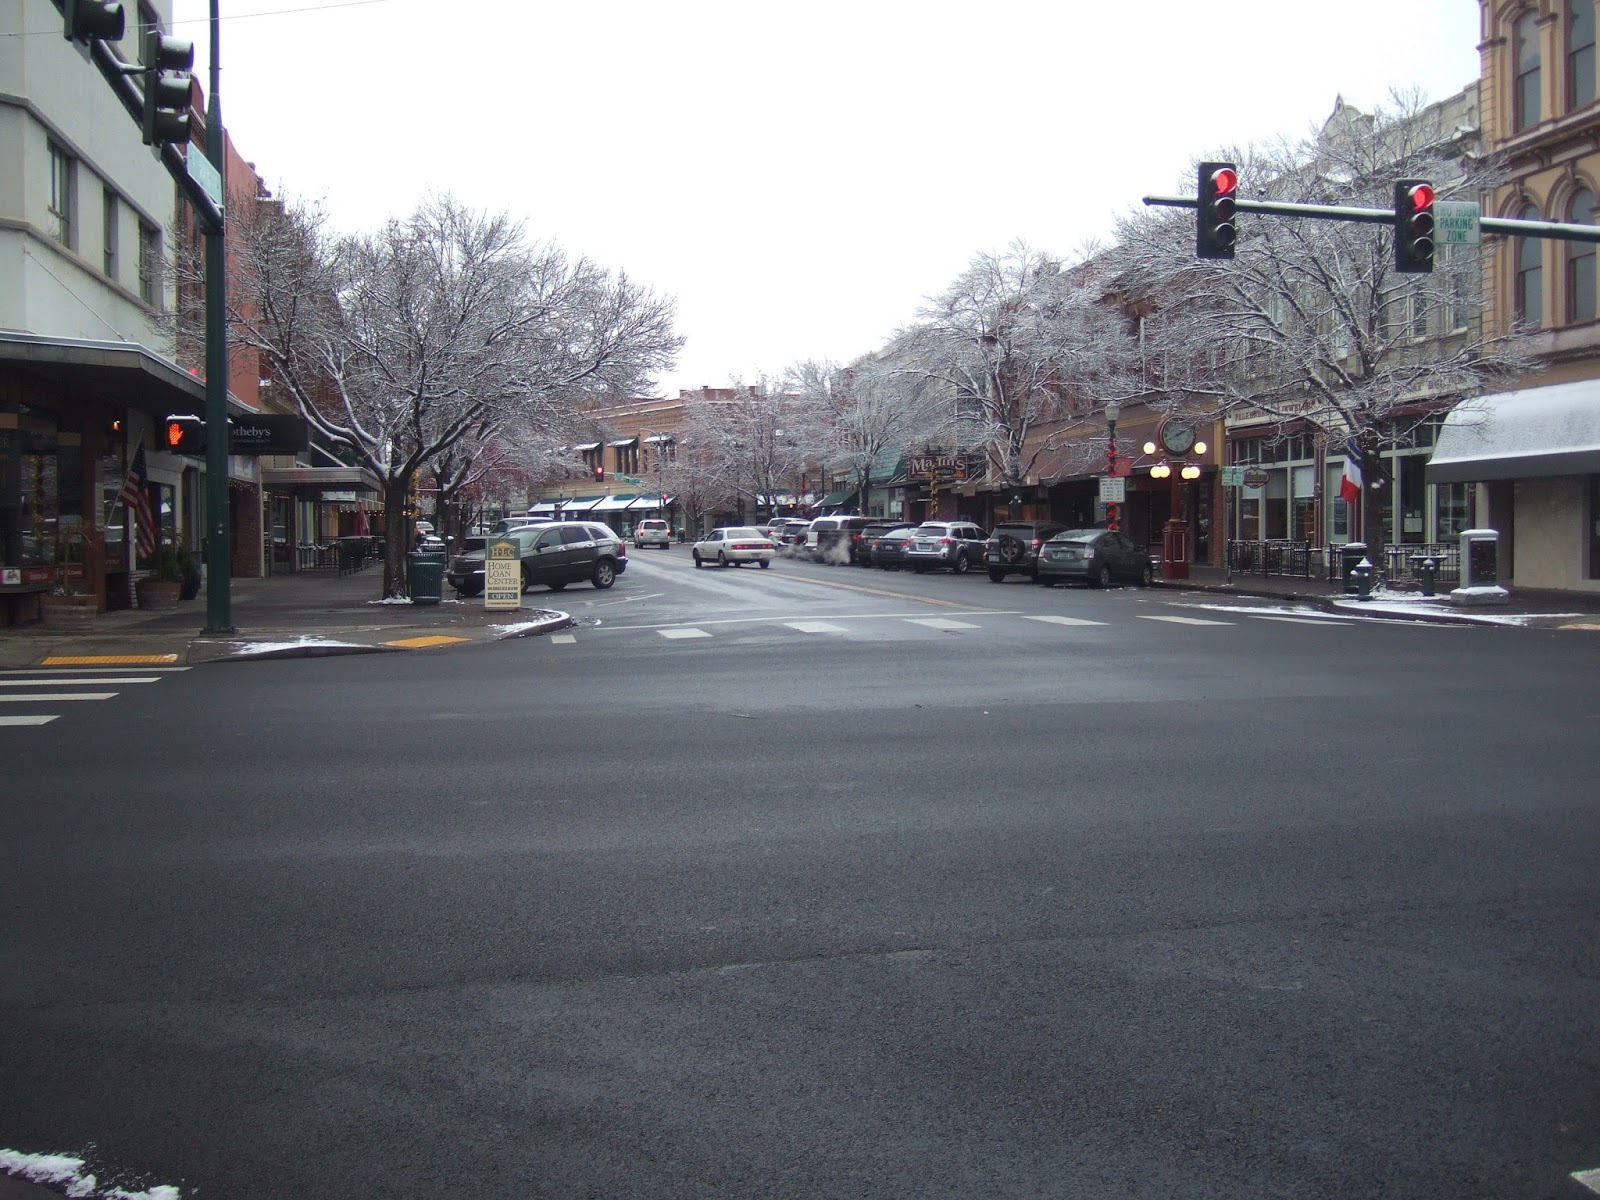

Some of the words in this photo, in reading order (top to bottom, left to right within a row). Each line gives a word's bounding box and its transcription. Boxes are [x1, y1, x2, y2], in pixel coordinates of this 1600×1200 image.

[1440, 218, 1472, 230] PARKING
[1446, 230, 1467, 242] ZONE
[232, 425, 271, 438] theby's
[488, 561, 511, 570] HOME
[488, 569, 510, 577] LOAN
[488, 577, 518, 585] CENTER
